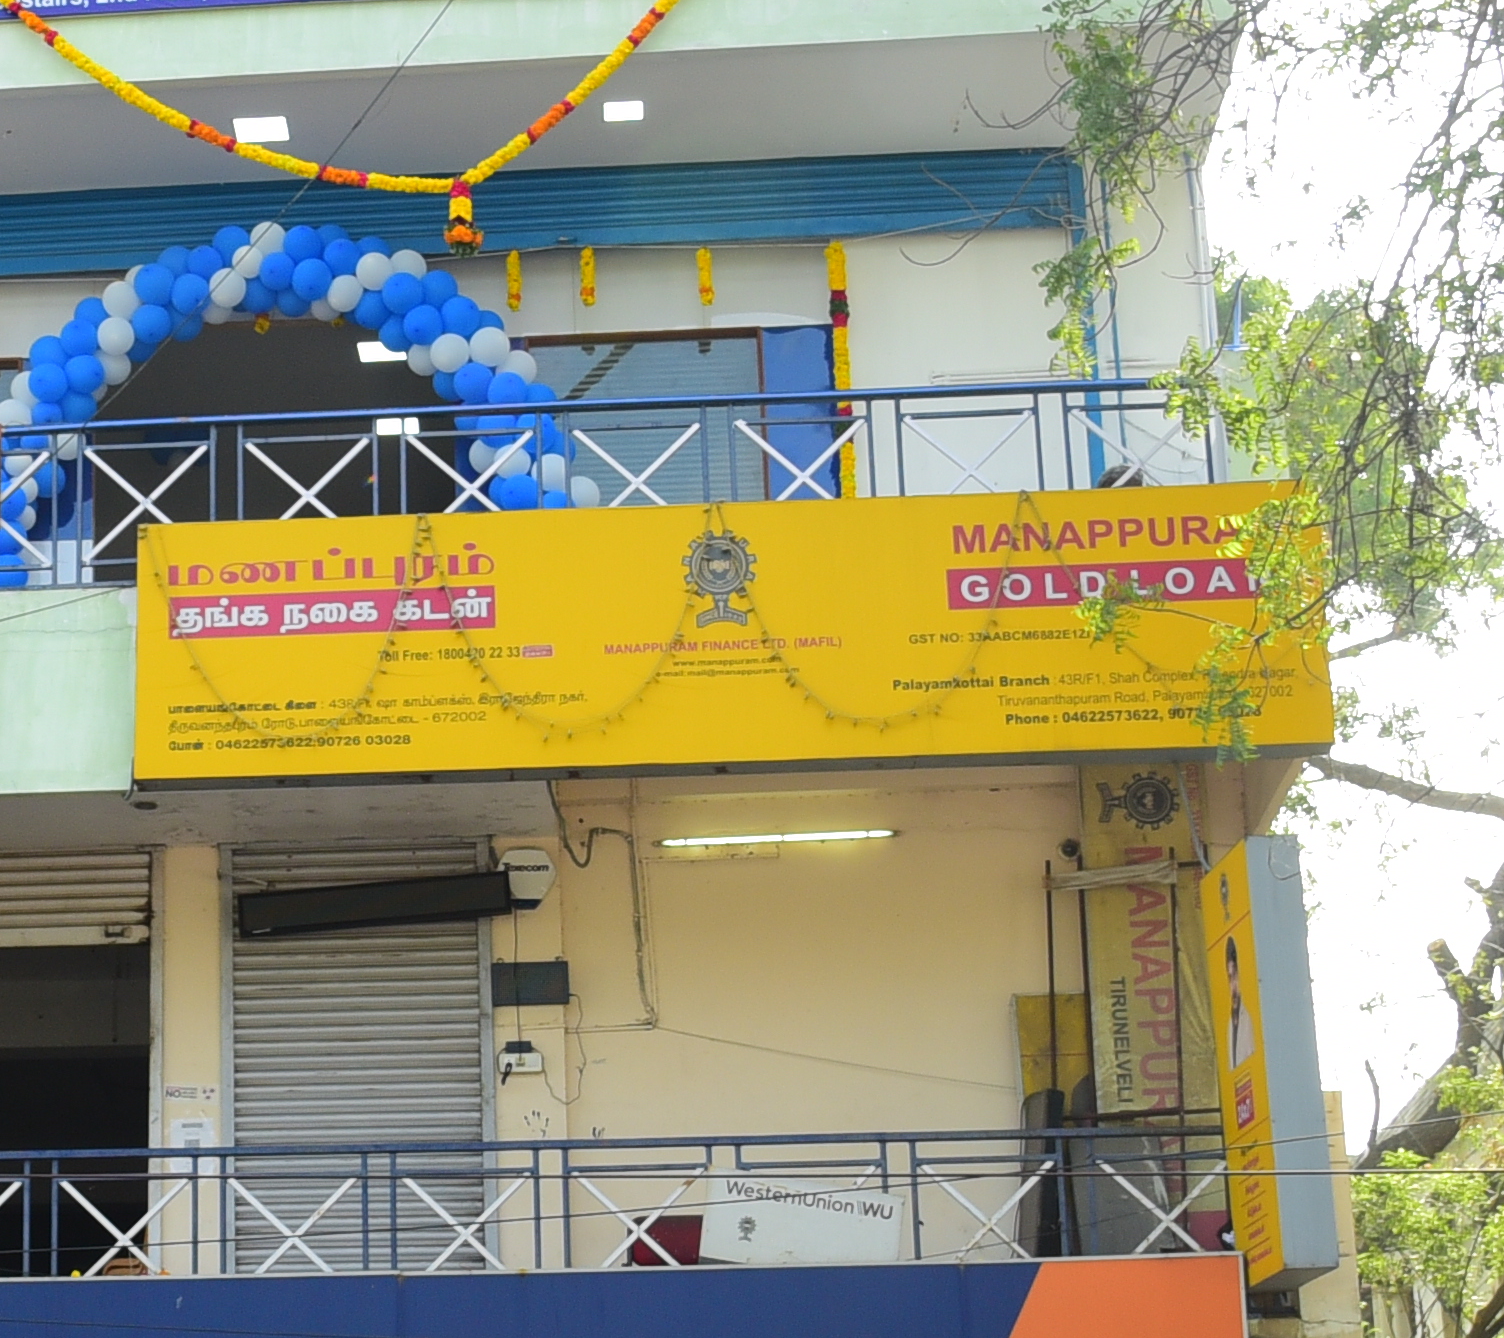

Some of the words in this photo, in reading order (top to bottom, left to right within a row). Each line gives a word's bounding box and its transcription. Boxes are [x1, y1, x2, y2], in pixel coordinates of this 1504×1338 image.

[952, 515, 1240, 555] MANAPPURA
[959, 570, 1106, 604] GOLD
[172, 597, 269, 637] தங்க
[279, 592, 379, 634] நகை
[394, 588, 492, 625] கடன்
[604, 641, 698, 655] MANAPPURAM
[702, 638, 758, 652] FINANCE
[793, 636, 842, 651] (MAFIL)
[908, 633, 935, 645] GST
[942, 633, 964, 643] NO:
[403, 649, 432, 661] Free:
[489, 646, 503, 659] 22
[506, 646, 520, 658] 33
[999, 674, 1050, 688] Branch
[1109, 672, 1139, 684] Shah
[432, 711, 487, 723] 672002
[1005, 714, 1049, 725] Phone
[365, 734, 411, 747] 03028
[1109, 976, 1134, 1103] TIRUNELVELI
[860, 1200, 895, 1221] WU
